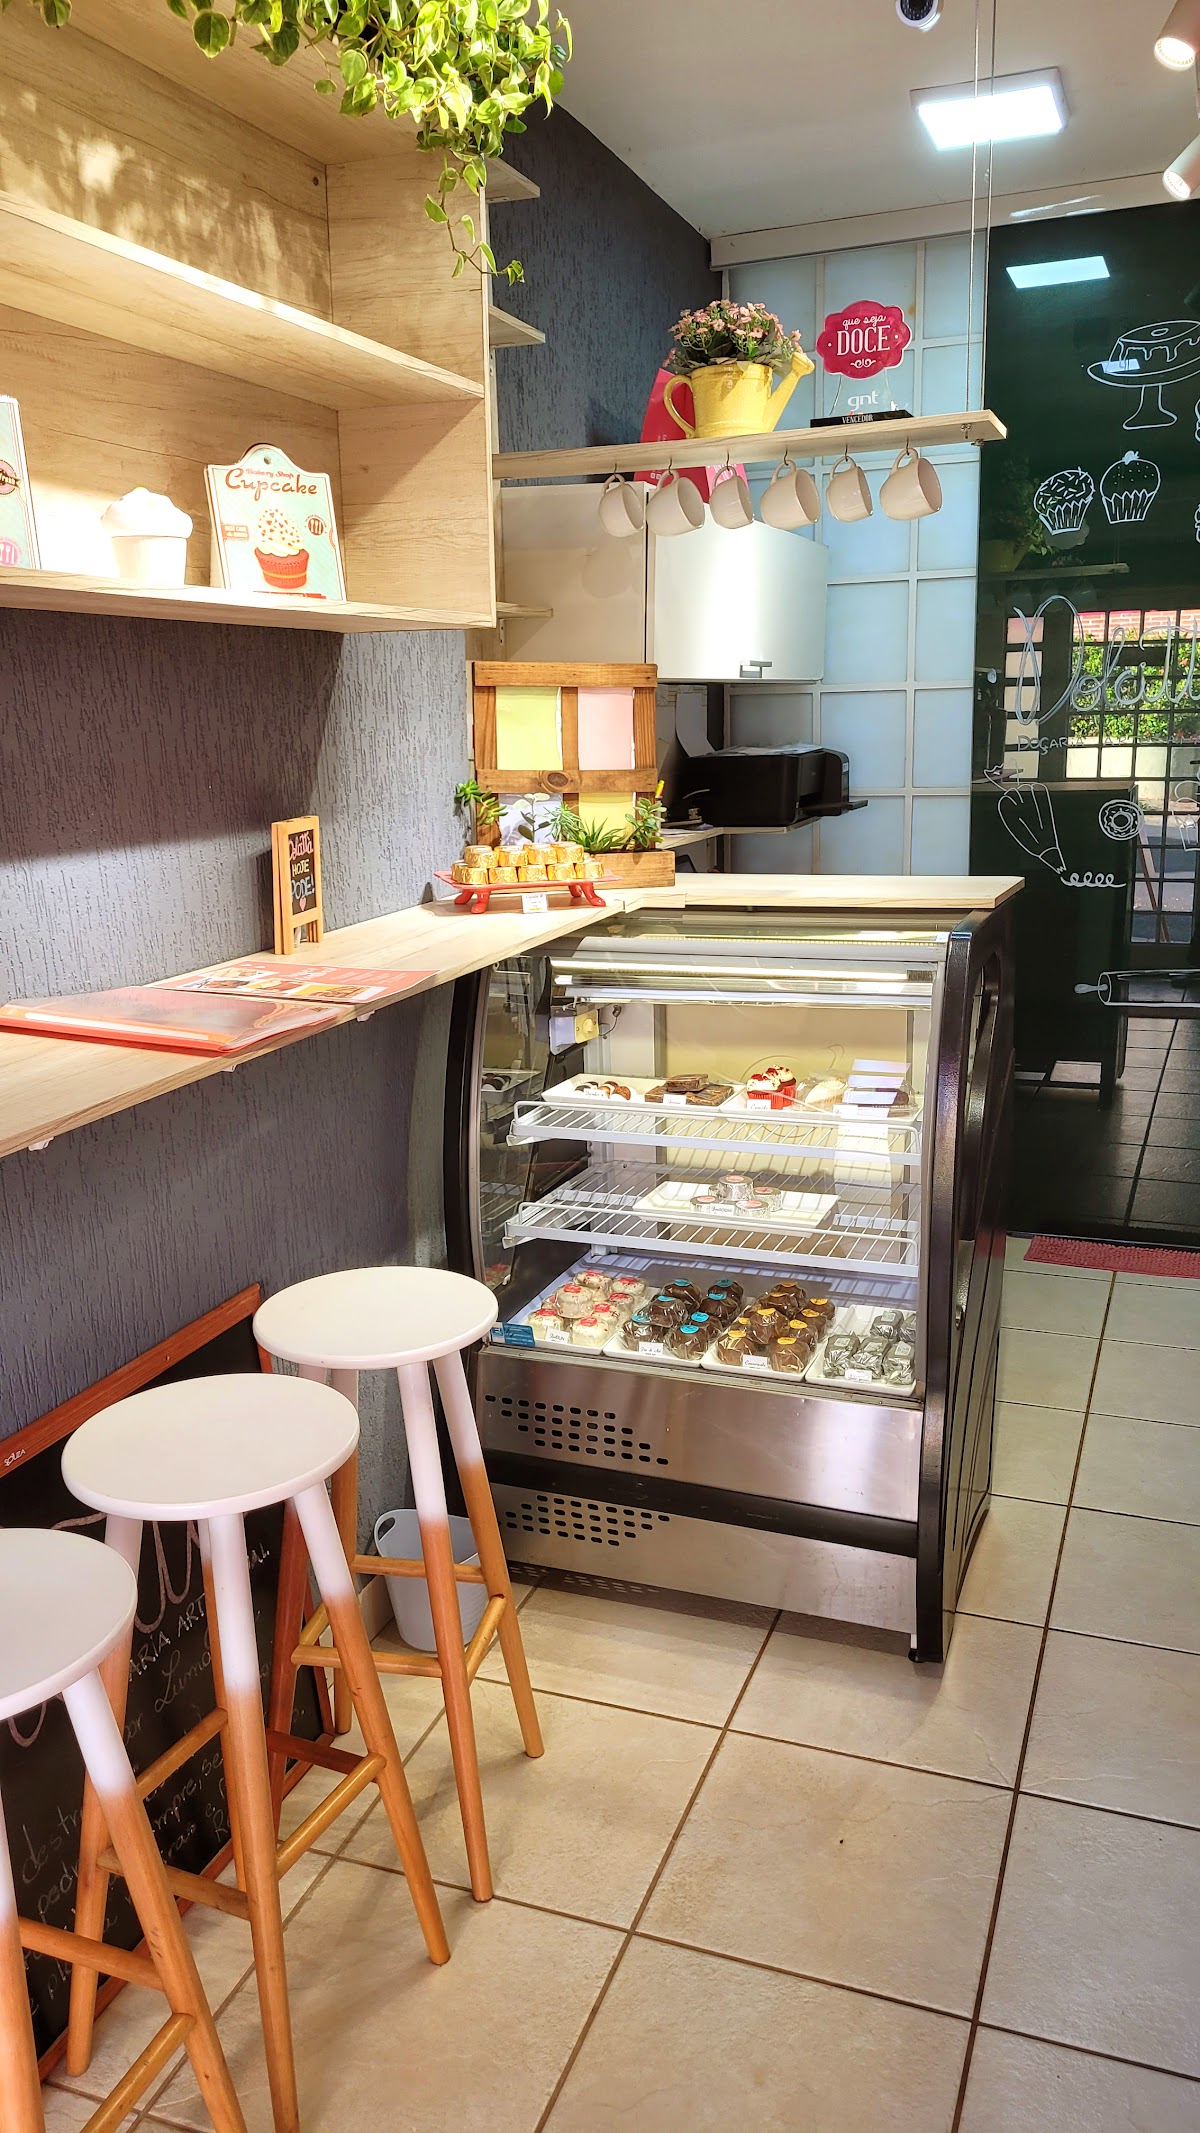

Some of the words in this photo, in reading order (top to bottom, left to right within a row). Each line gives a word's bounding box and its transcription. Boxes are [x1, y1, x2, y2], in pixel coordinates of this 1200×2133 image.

[842, 318, 861, 330] que
[863, 314, 887, 327] seja
[837, 325, 890, 355] DOCE
[848, 391, 878, 410] gnt
[841, 414, 874, 424] VENCEDOR
[225, 467, 318, 502] Cupcake
[292, 859, 309, 876] HOJE
